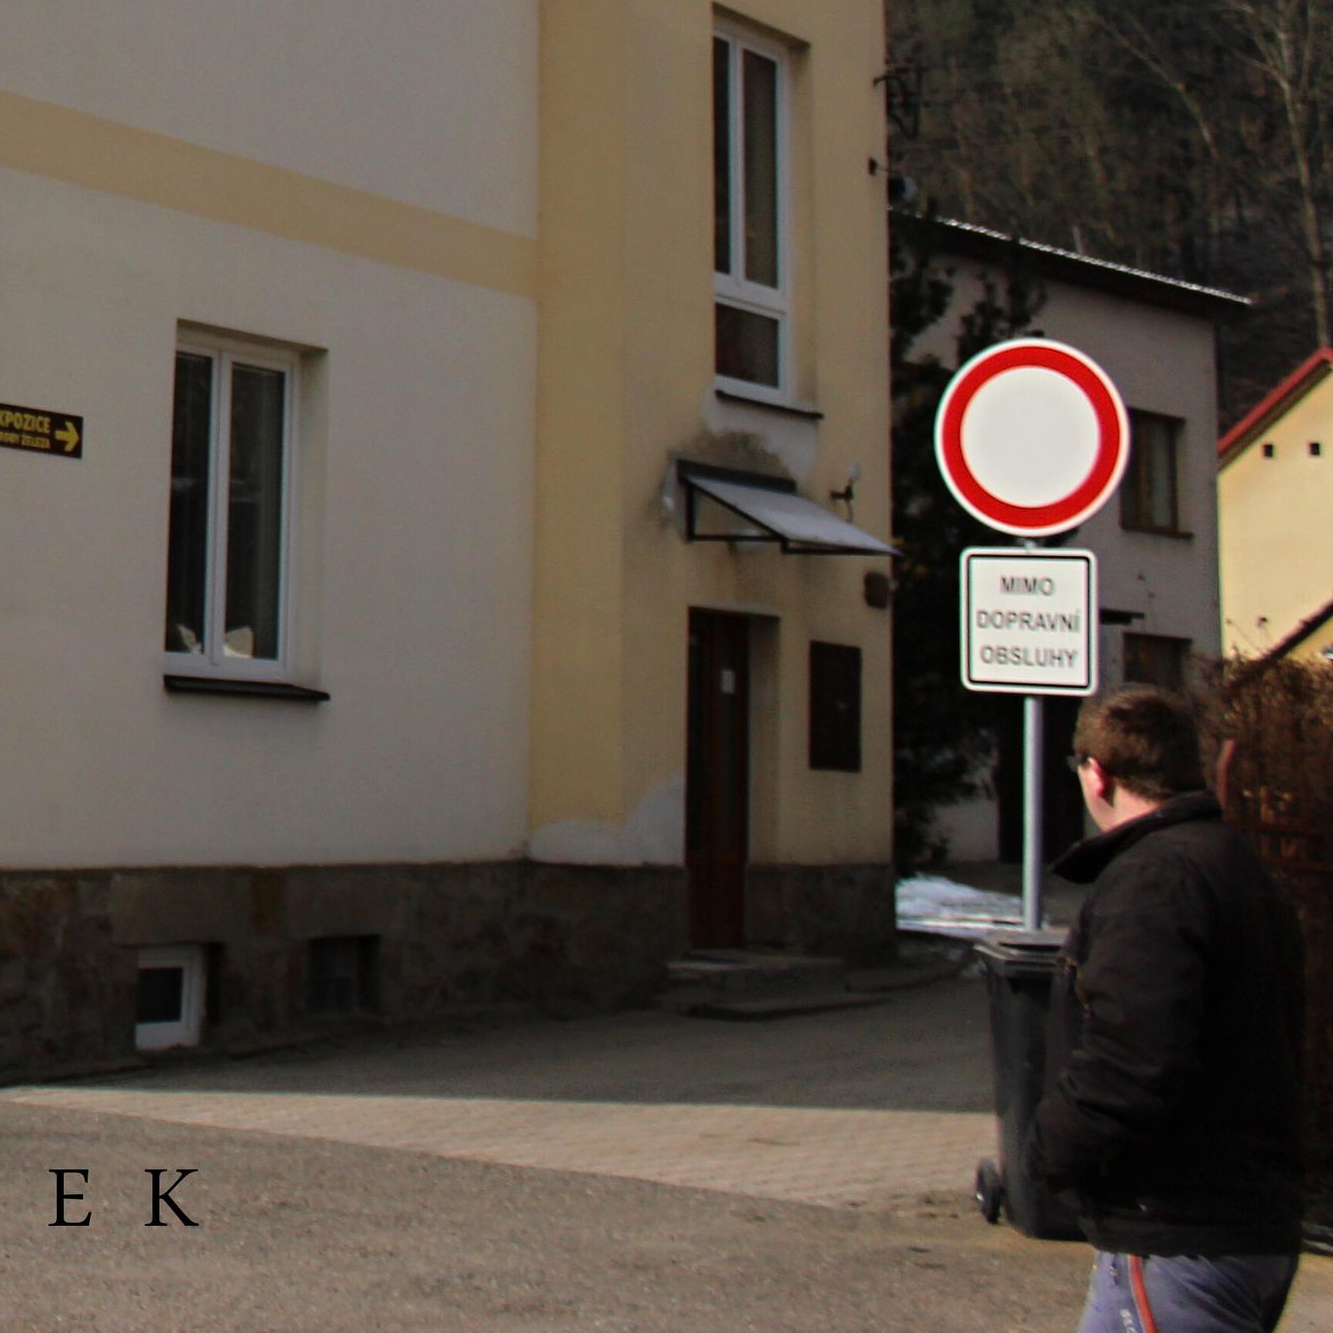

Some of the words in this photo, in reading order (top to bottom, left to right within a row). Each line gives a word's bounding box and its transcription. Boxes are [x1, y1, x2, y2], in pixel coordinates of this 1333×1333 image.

[999, 576, 1055, 596] MIMO
[976, 609, 1081, 633] DOPRAVNÍ
[980, 645, 1078, 668] OBSLUHY
